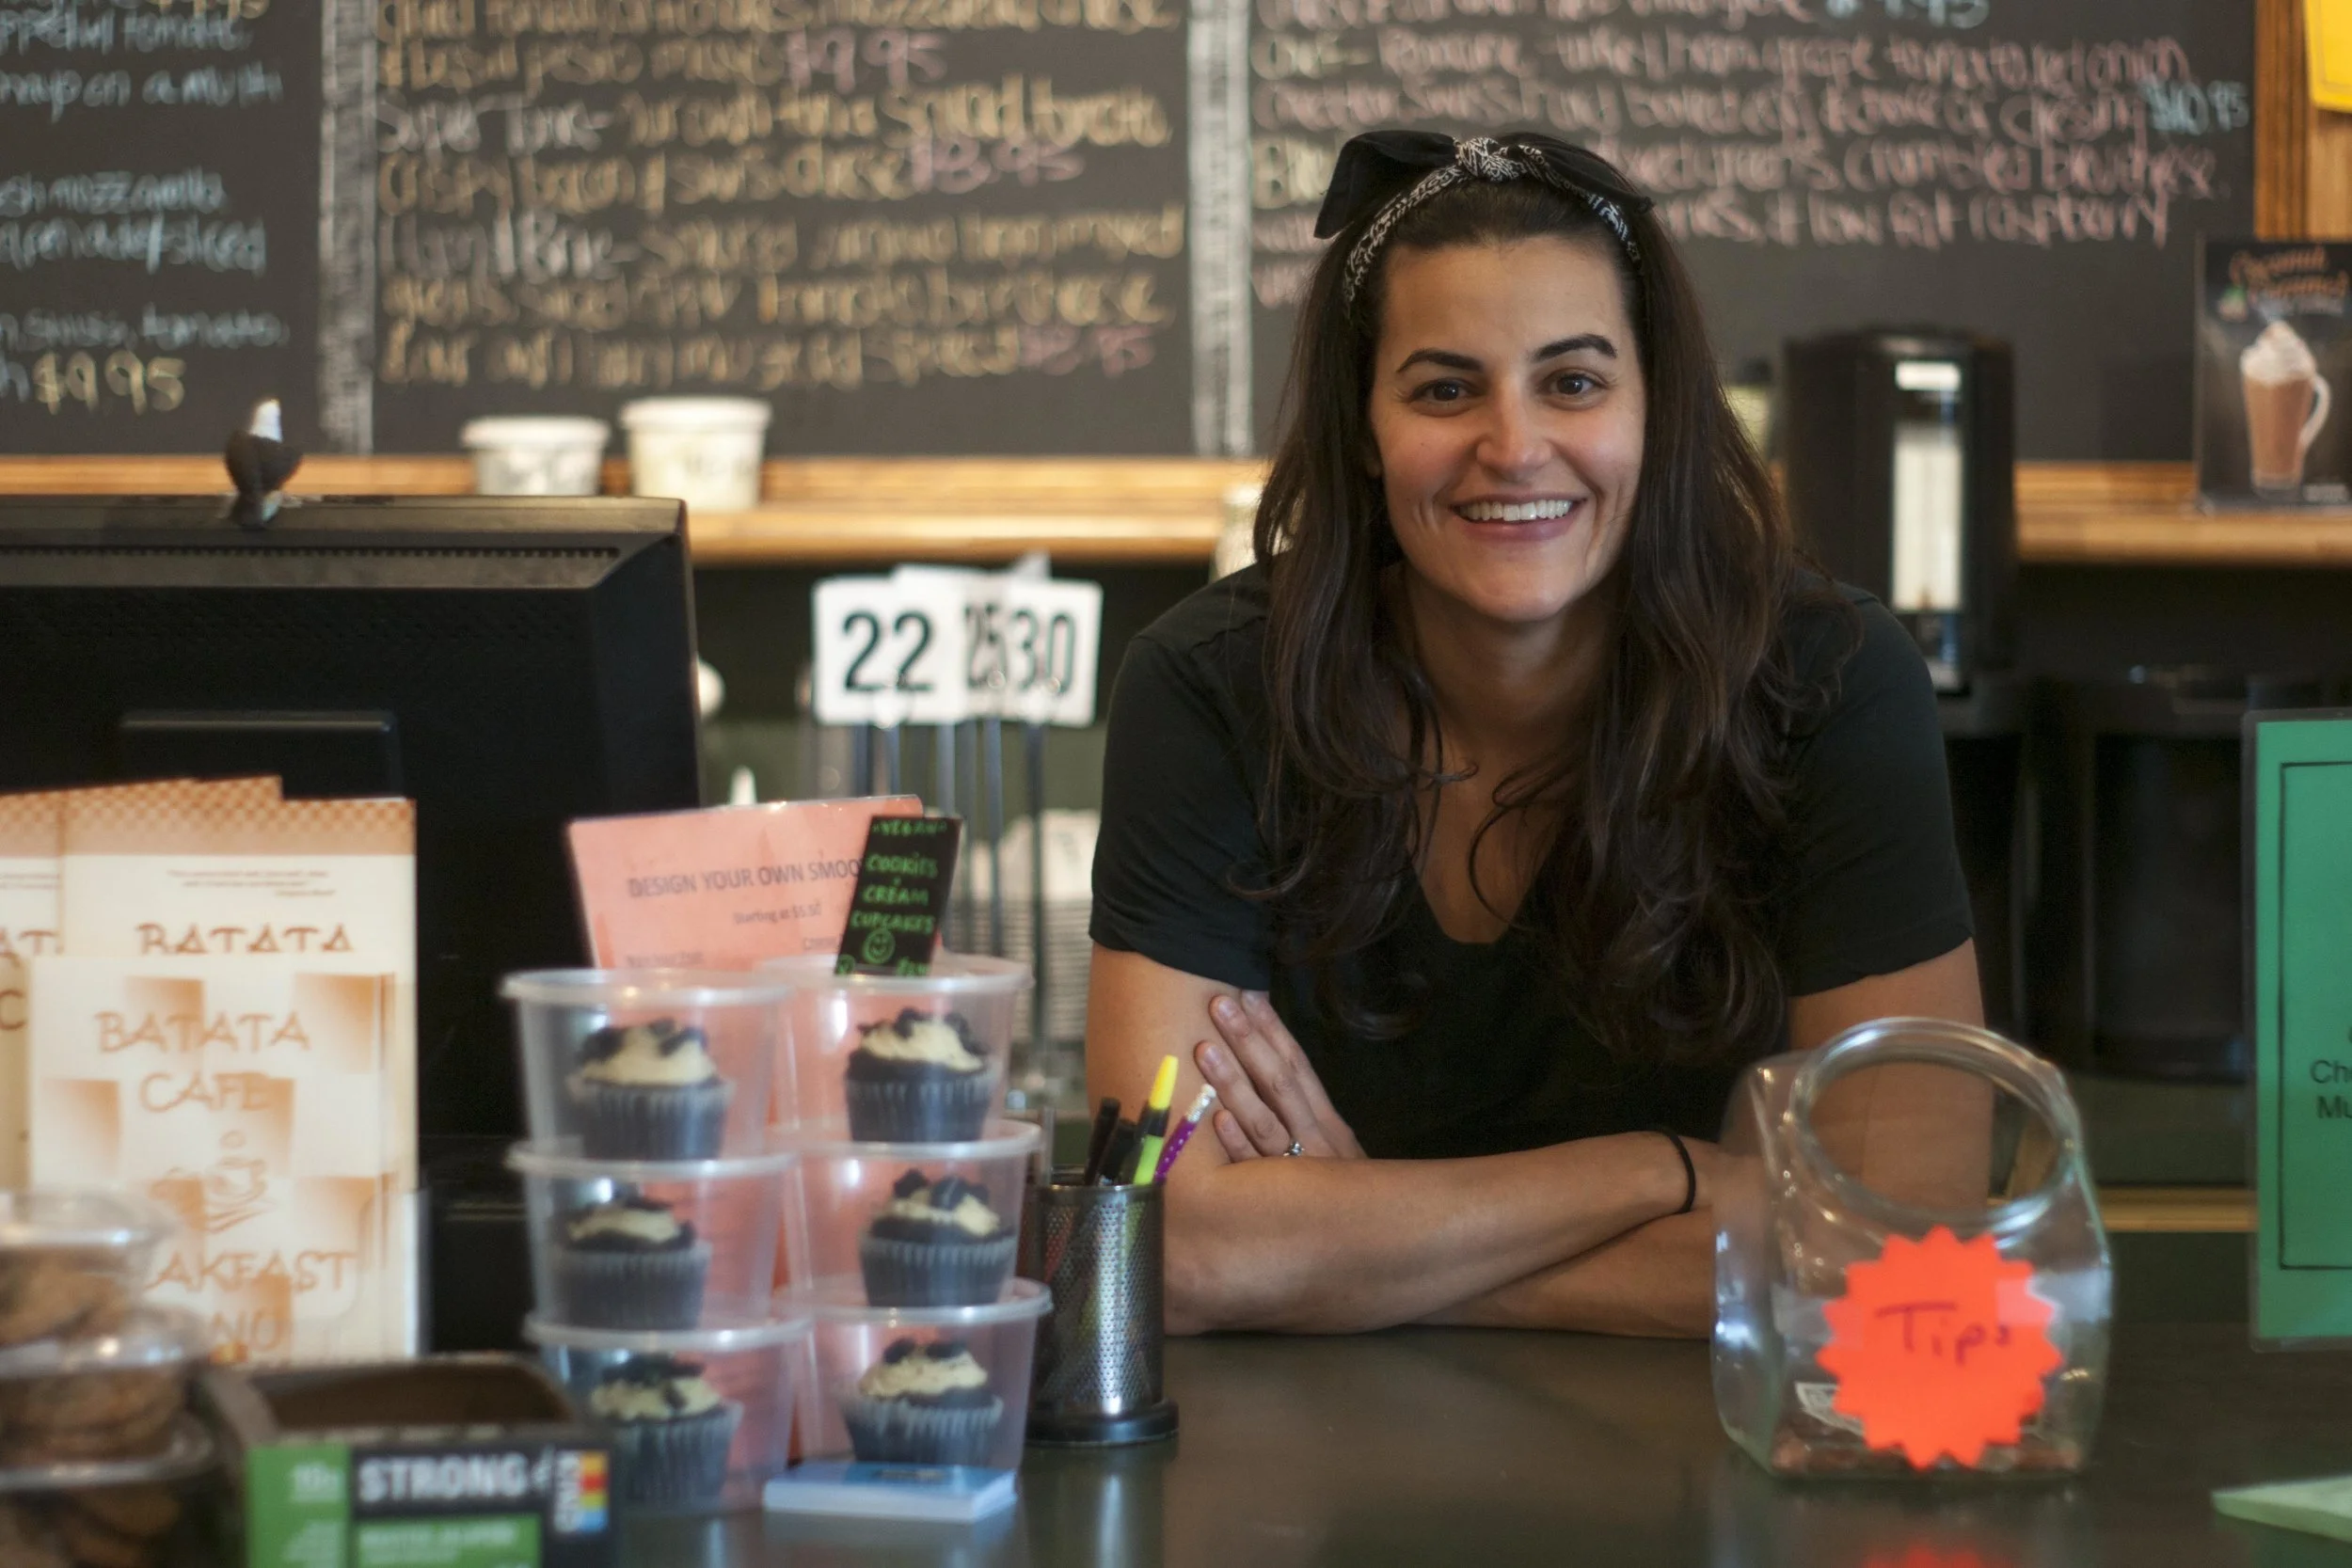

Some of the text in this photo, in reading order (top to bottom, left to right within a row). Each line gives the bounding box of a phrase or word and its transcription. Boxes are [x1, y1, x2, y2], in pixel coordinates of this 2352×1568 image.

[841, 609, 936, 693] 22
[1013, 610, 1076, 694] 30
[628, 858, 863, 897] DESIGN YOUR OWN SMOO
[733, 909, 778, 926] Starting
[780, 910, 791, 922] at
[95, 1010, 312, 1054] BATATA
[1875, 1301, 2012, 1367] Tips
[358, 1453, 529, 1503] STRONG
